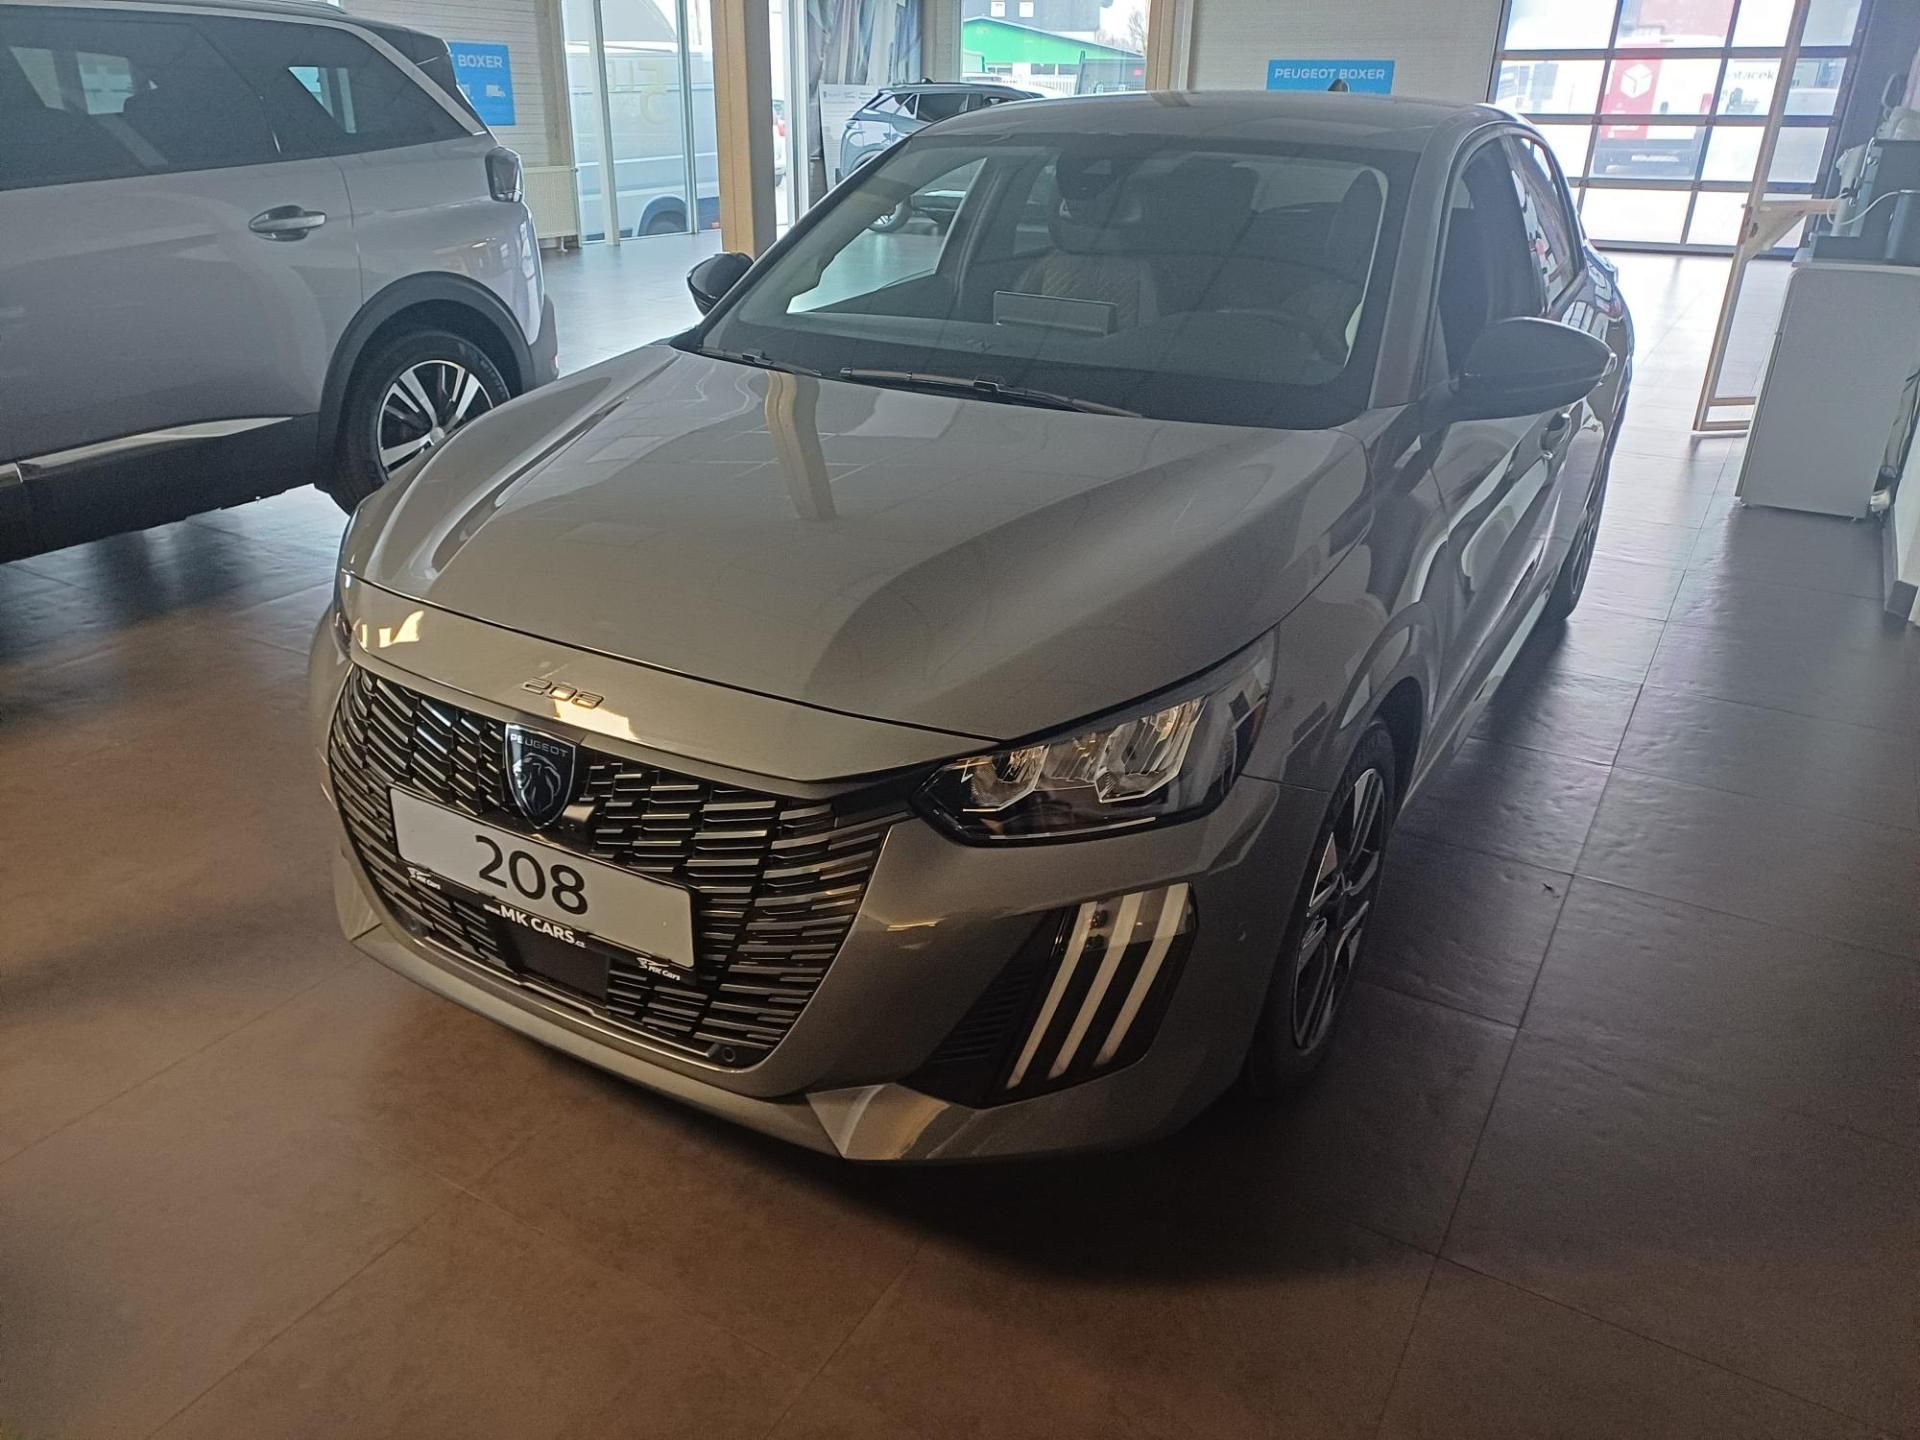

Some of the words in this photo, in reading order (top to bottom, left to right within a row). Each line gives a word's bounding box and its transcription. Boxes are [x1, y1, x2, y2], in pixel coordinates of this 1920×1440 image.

[457, 53, 503, 69] BOXER
[1274, 67, 1336, 79] PEUGEOT
[1339, 68, 1385, 80] BOXER
[521, 677, 605, 710] 208
[510, 733, 568, 757] PEUGEOT
[475, 835, 588, 915] 208
